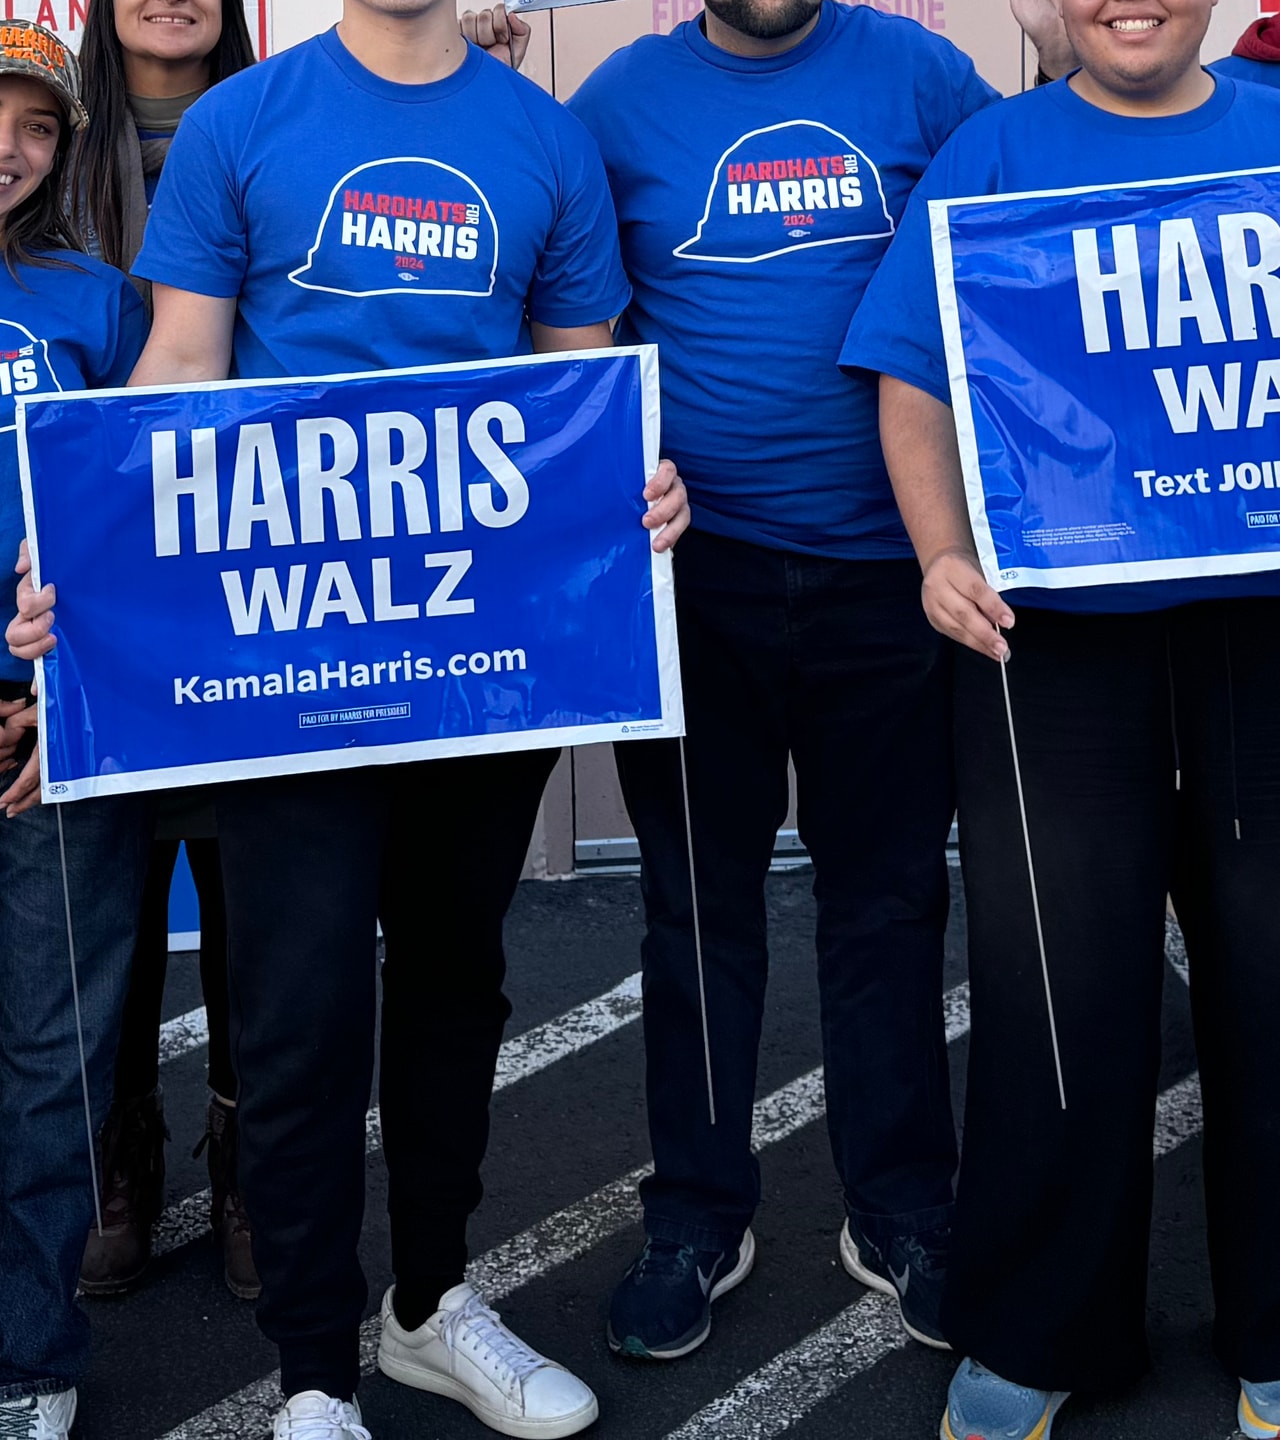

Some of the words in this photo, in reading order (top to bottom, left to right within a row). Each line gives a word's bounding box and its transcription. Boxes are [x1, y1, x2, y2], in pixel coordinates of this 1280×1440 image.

[727, 155, 846, 182] HARDHATS
[843, 154, 859, 175] FOR
[343, 189, 467, 224] HARDHATS
[465, 203, 480, 225] FOR
[727, 176, 863, 215] HARRIS
[341, 211, 479, 261] HARRIS
[783, 214, 814, 226] 2024
[394, 255, 424, 270] 2024
[151, 400, 530, 557] HARRIS
[1134, 467, 1211, 498] Text
[1250, 515, 1265, 525] PAID
[1266, 514, 1279, 524] FOR
[221, 549, 475, 636] WALZ
[173, 647, 526, 705] KamalaHarris.com
